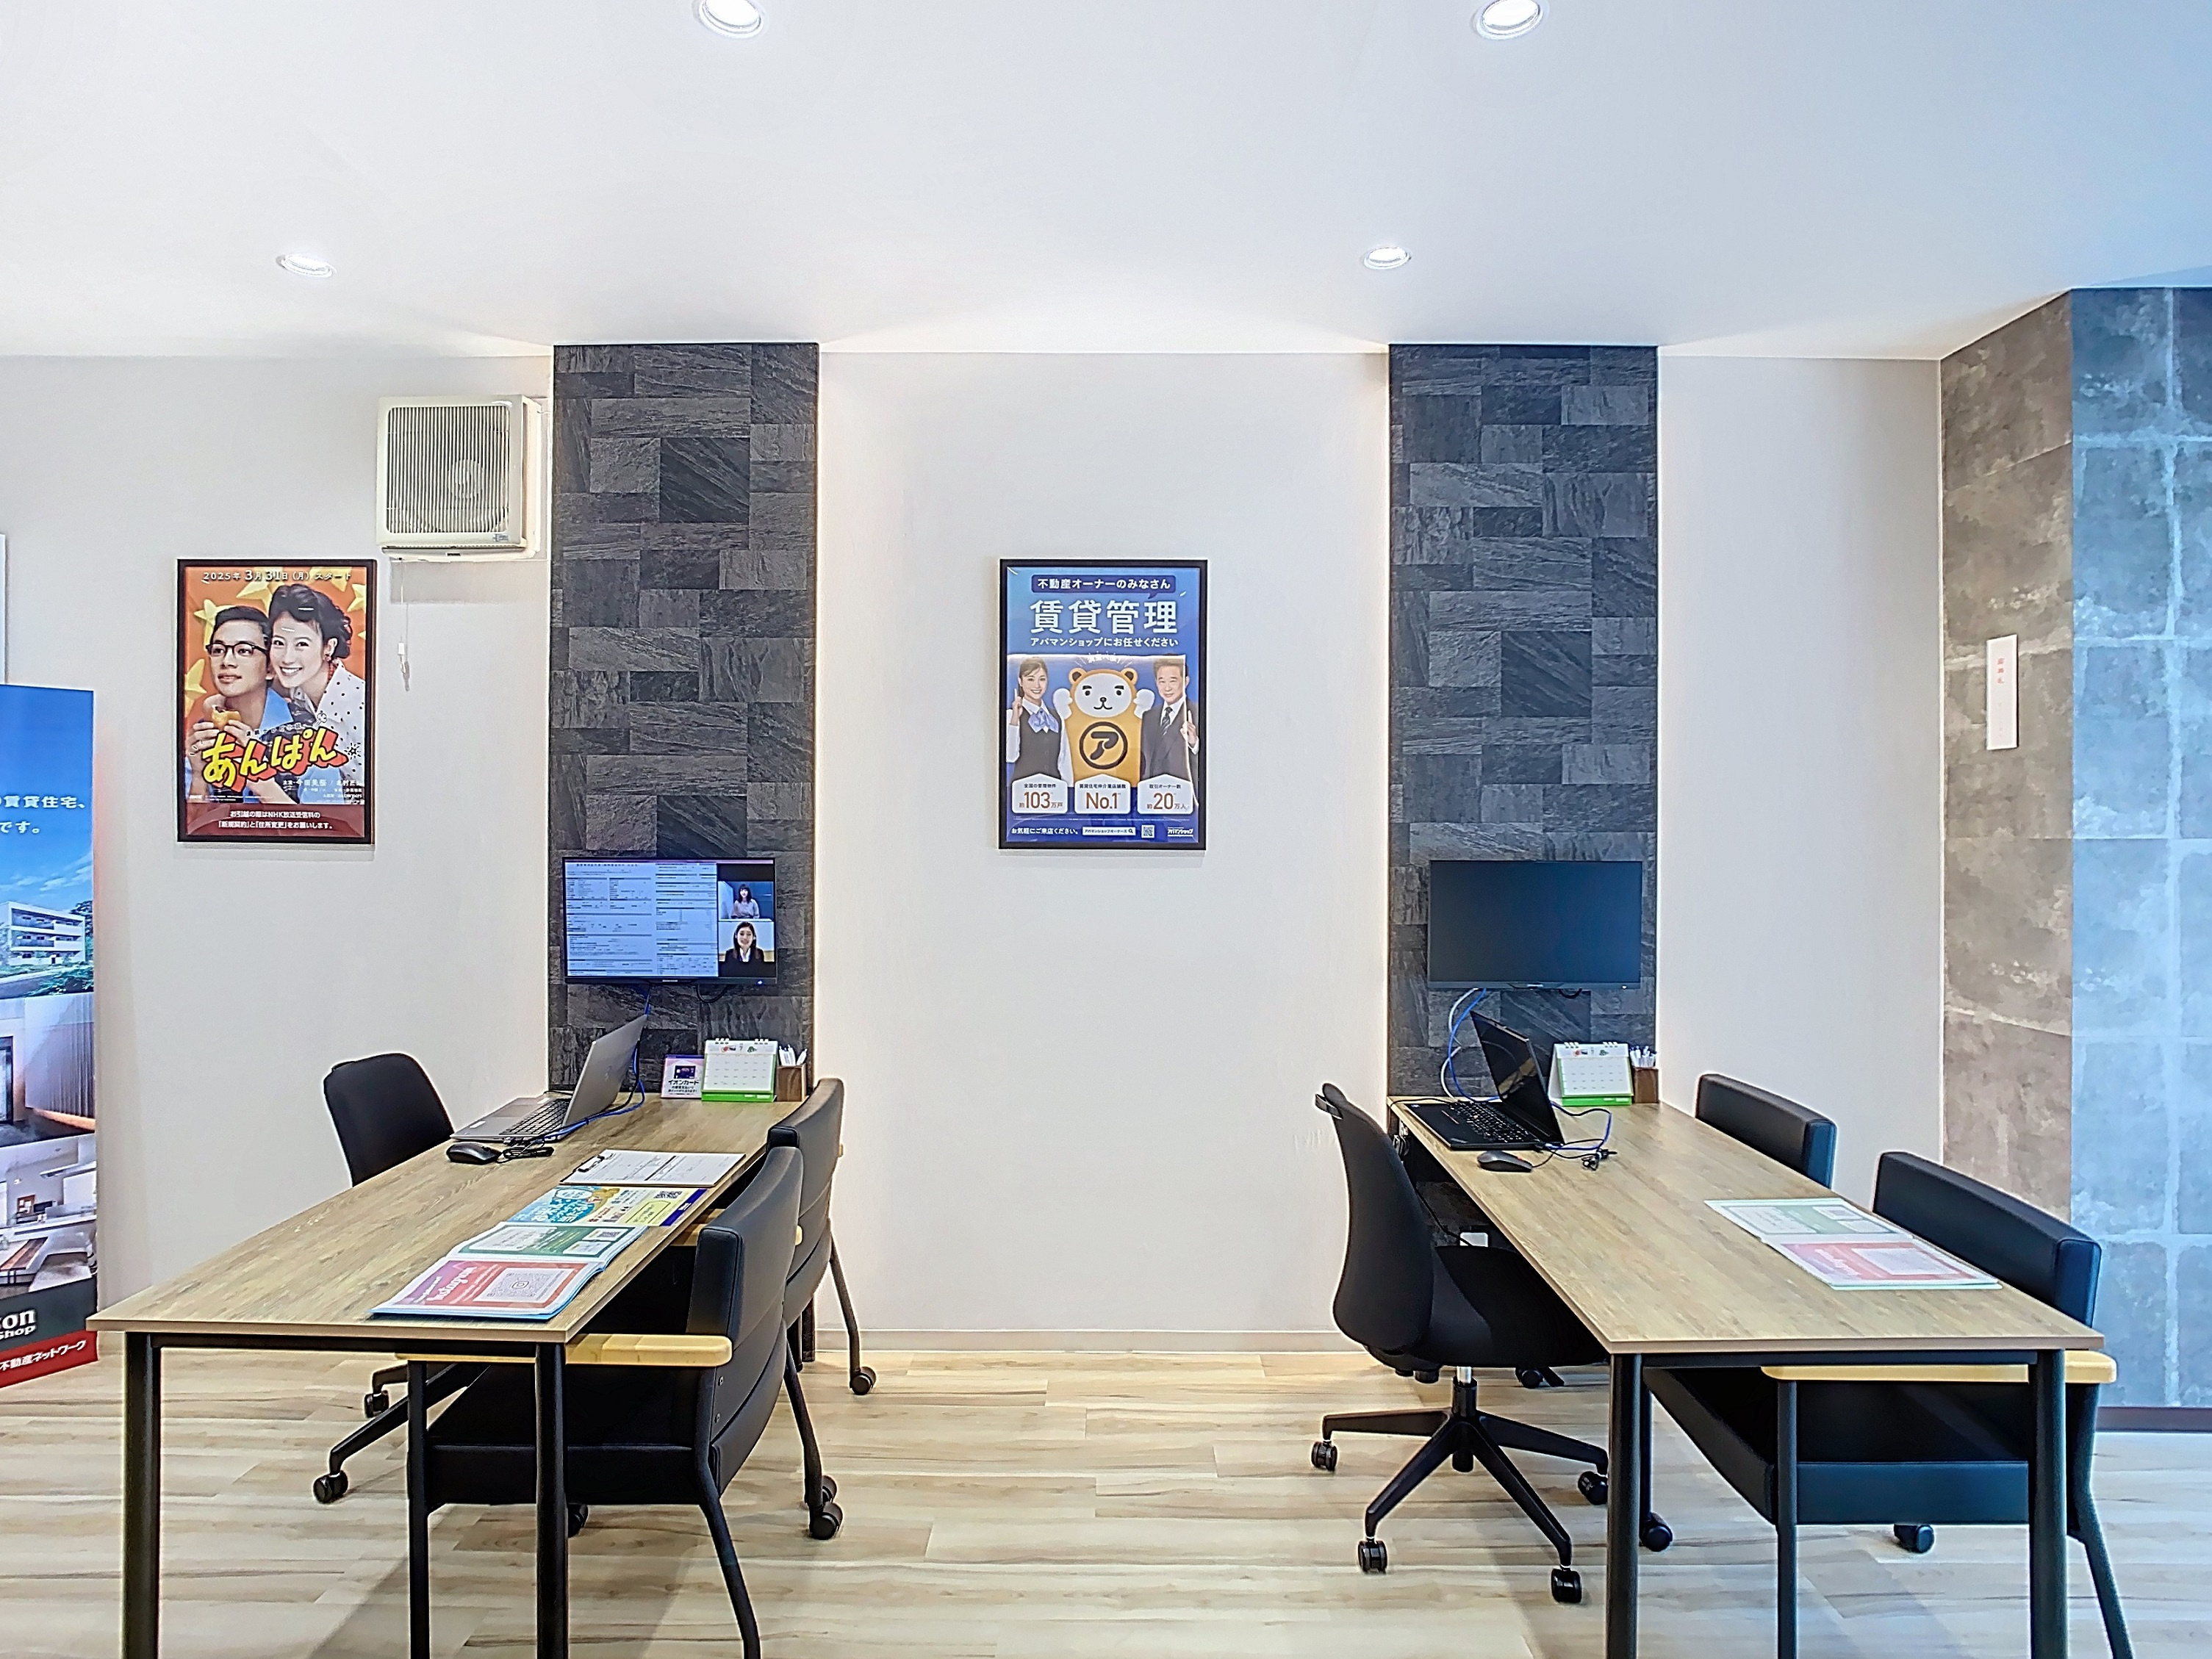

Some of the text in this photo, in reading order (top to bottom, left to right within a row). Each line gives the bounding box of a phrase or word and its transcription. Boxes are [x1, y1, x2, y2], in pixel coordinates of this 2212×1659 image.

[1037, 578, 1171, 589] 不動産オーナーのみなさん
[1030, 600, 1178, 634] 賃貸管理
[1030, 637, 1179, 647] アパマンショップにお任せください
[202, 727, 340, 791] あんぱん
[0, 796, 85, 808] 賃貸住宅、
[425, 1266, 478, 1301] Instagram
